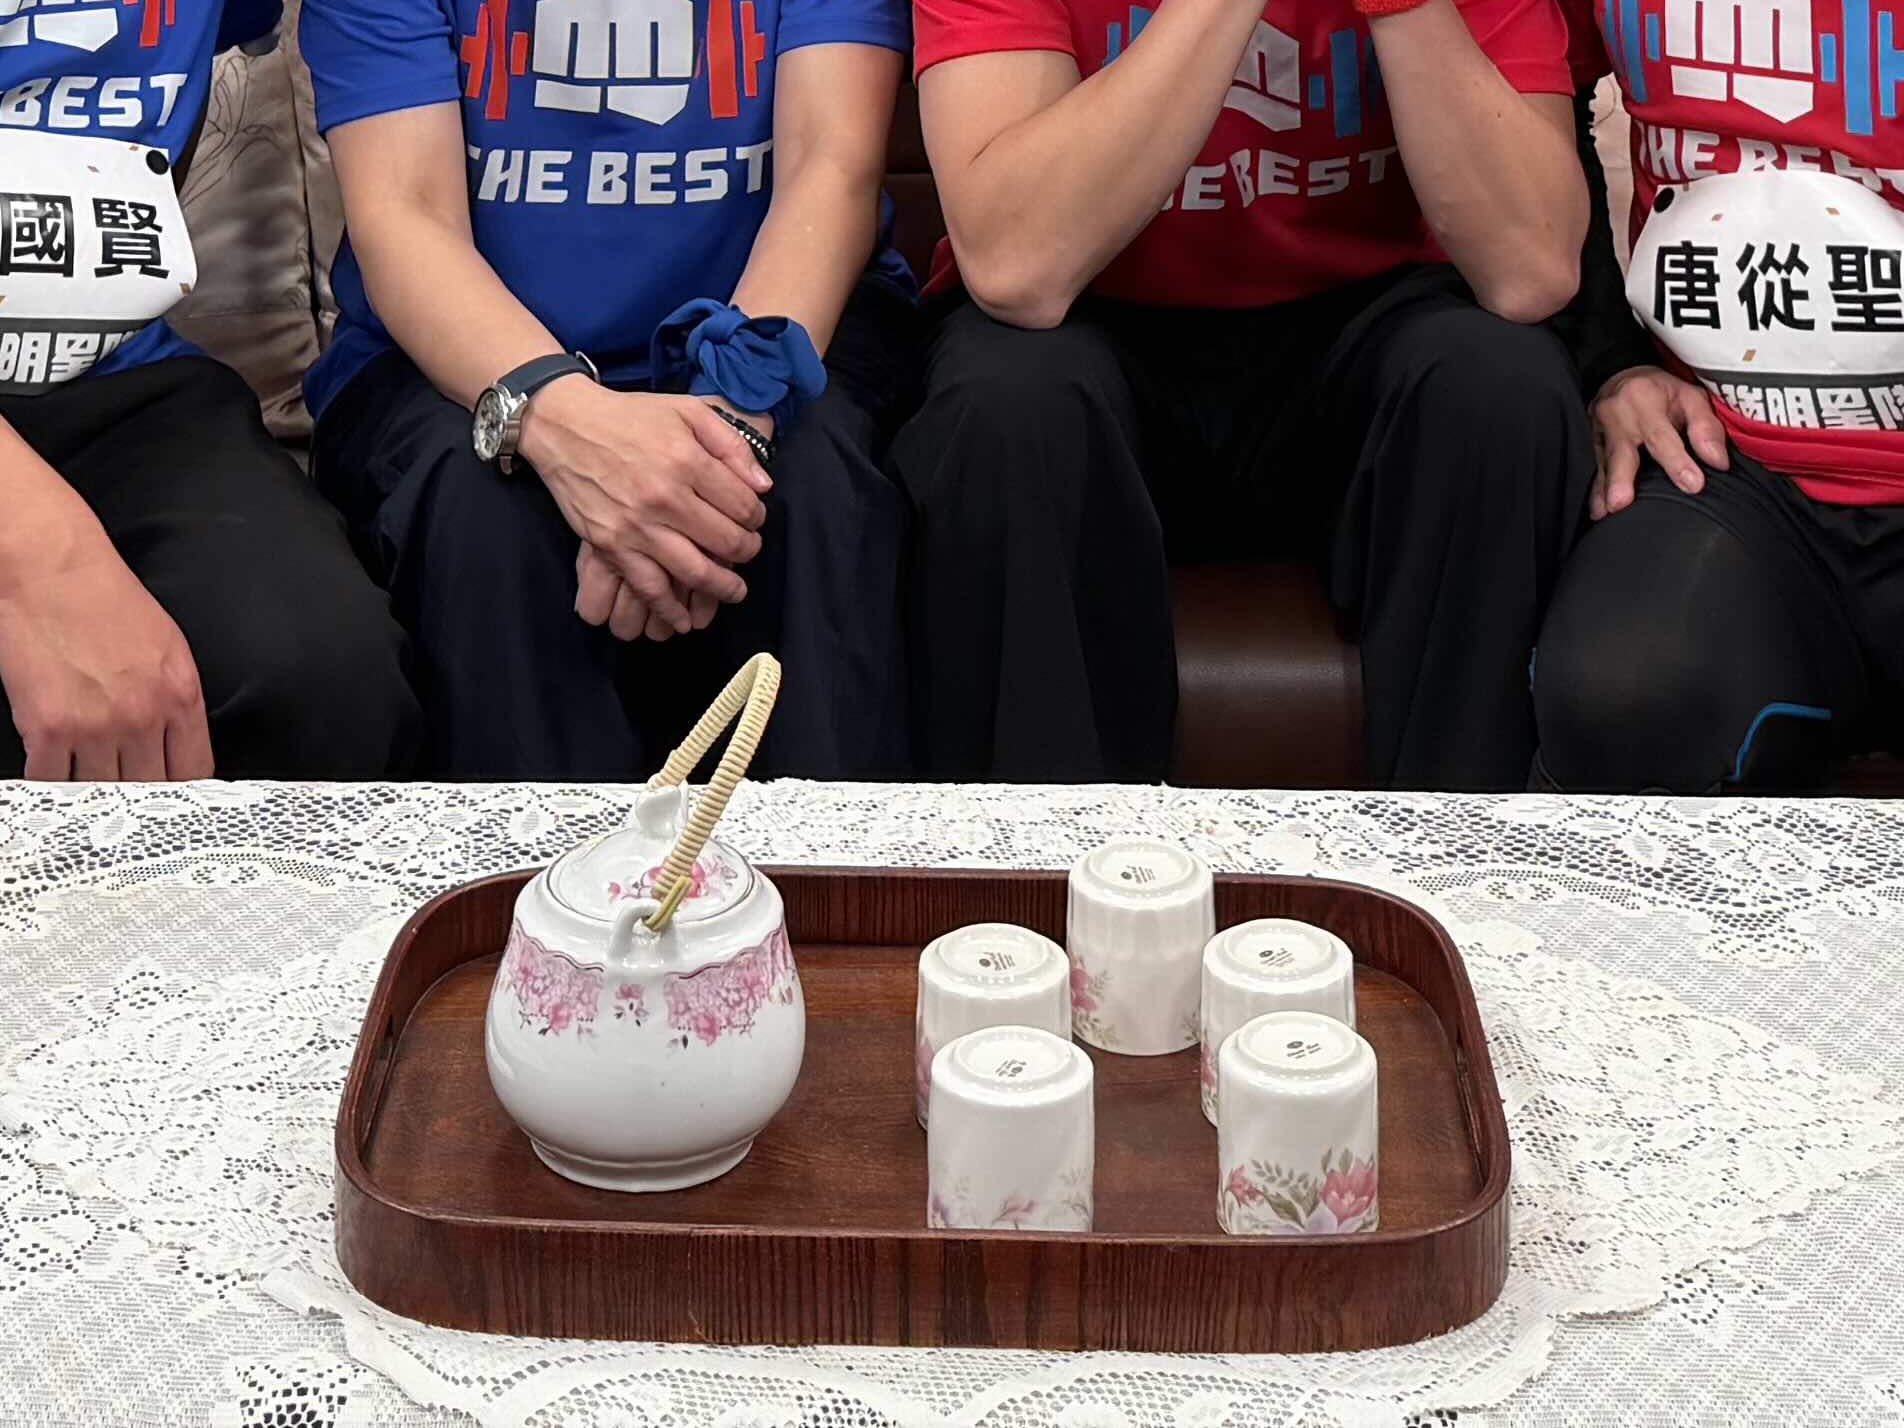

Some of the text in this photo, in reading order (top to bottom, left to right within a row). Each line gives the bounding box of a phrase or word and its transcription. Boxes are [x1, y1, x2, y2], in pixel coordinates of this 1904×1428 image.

[0, 73, 189, 129] BEST
[586, 139, 773, 205] BEST
[1229, 145, 1397, 209] BEST
